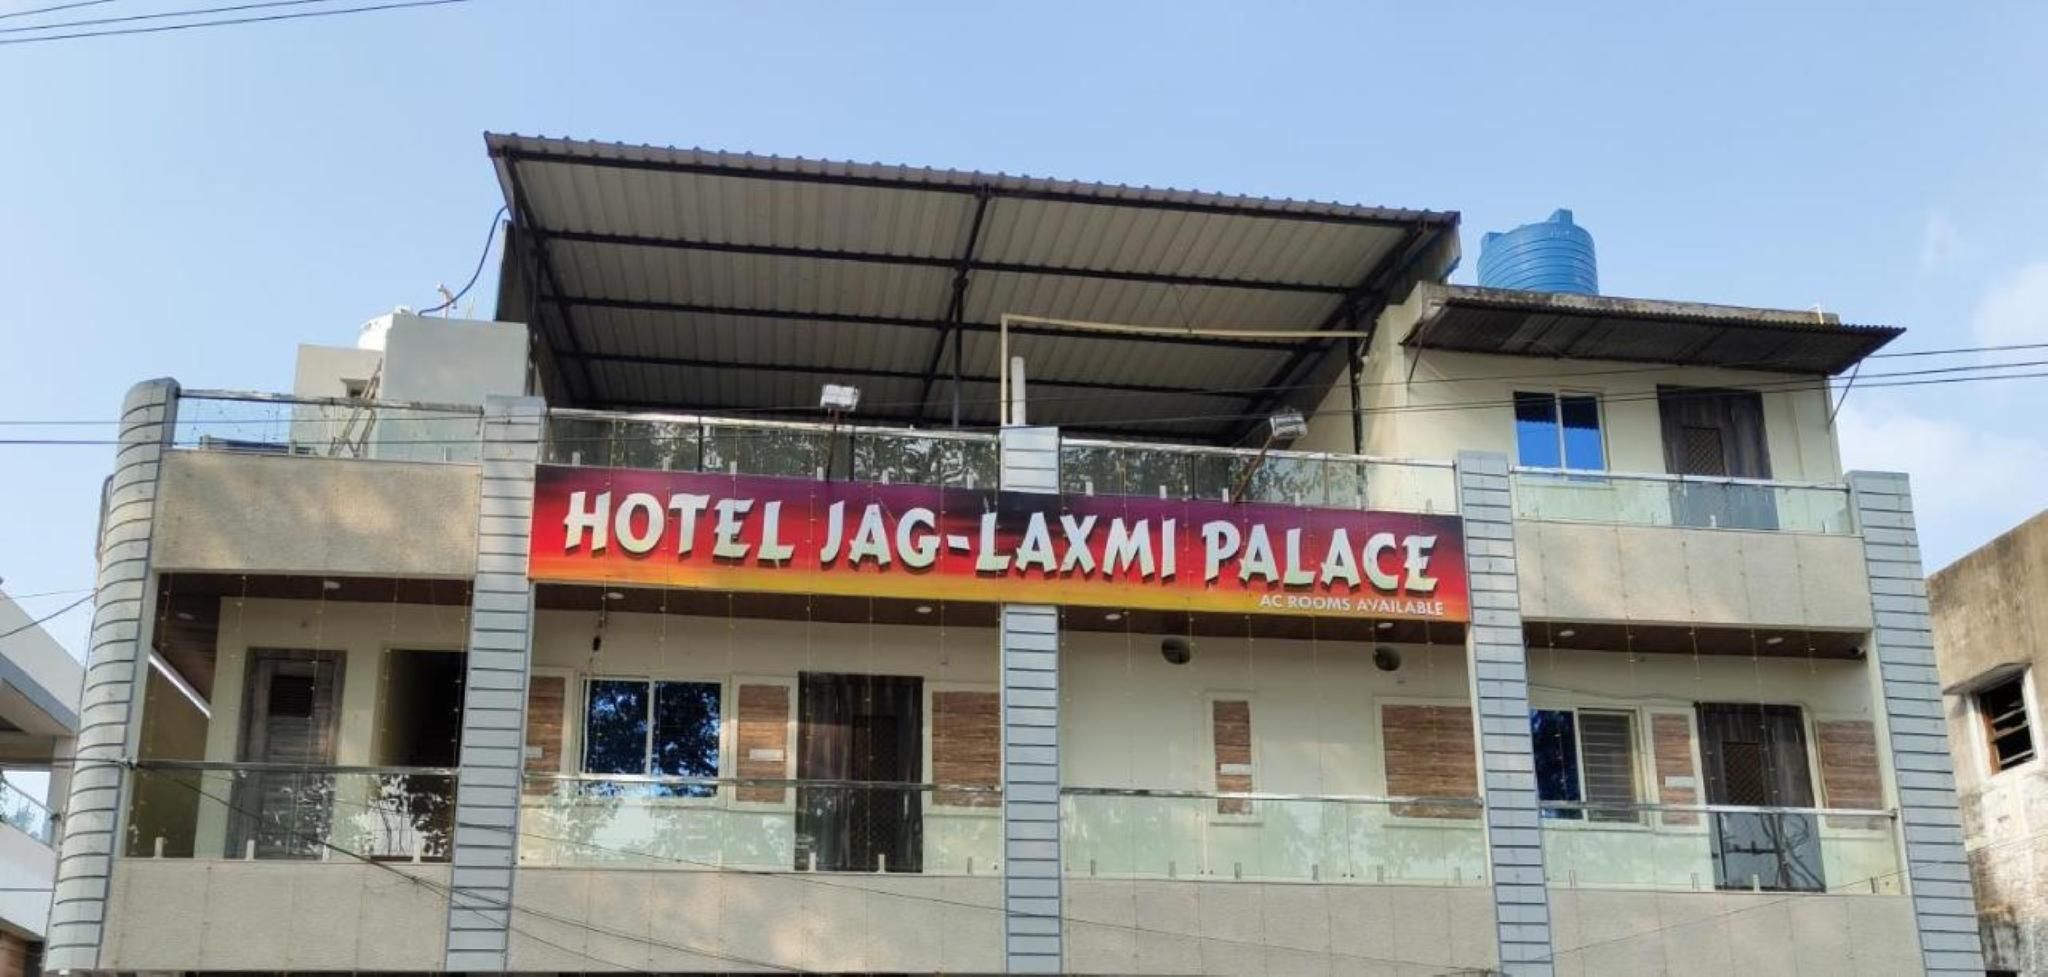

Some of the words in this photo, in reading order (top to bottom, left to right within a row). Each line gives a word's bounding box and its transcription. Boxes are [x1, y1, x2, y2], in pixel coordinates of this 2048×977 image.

[563, 491, 795, 561] HOTEL
[820, 500, 1176, 578] JAG-LAXMI
[1202, 520, 1439, 592] PALACE
[1260, 594, 1283, 608] AC
[1287, 595, 1351, 612] ROOMS
[1356, 599, 1444, 616] AVAILABLE
